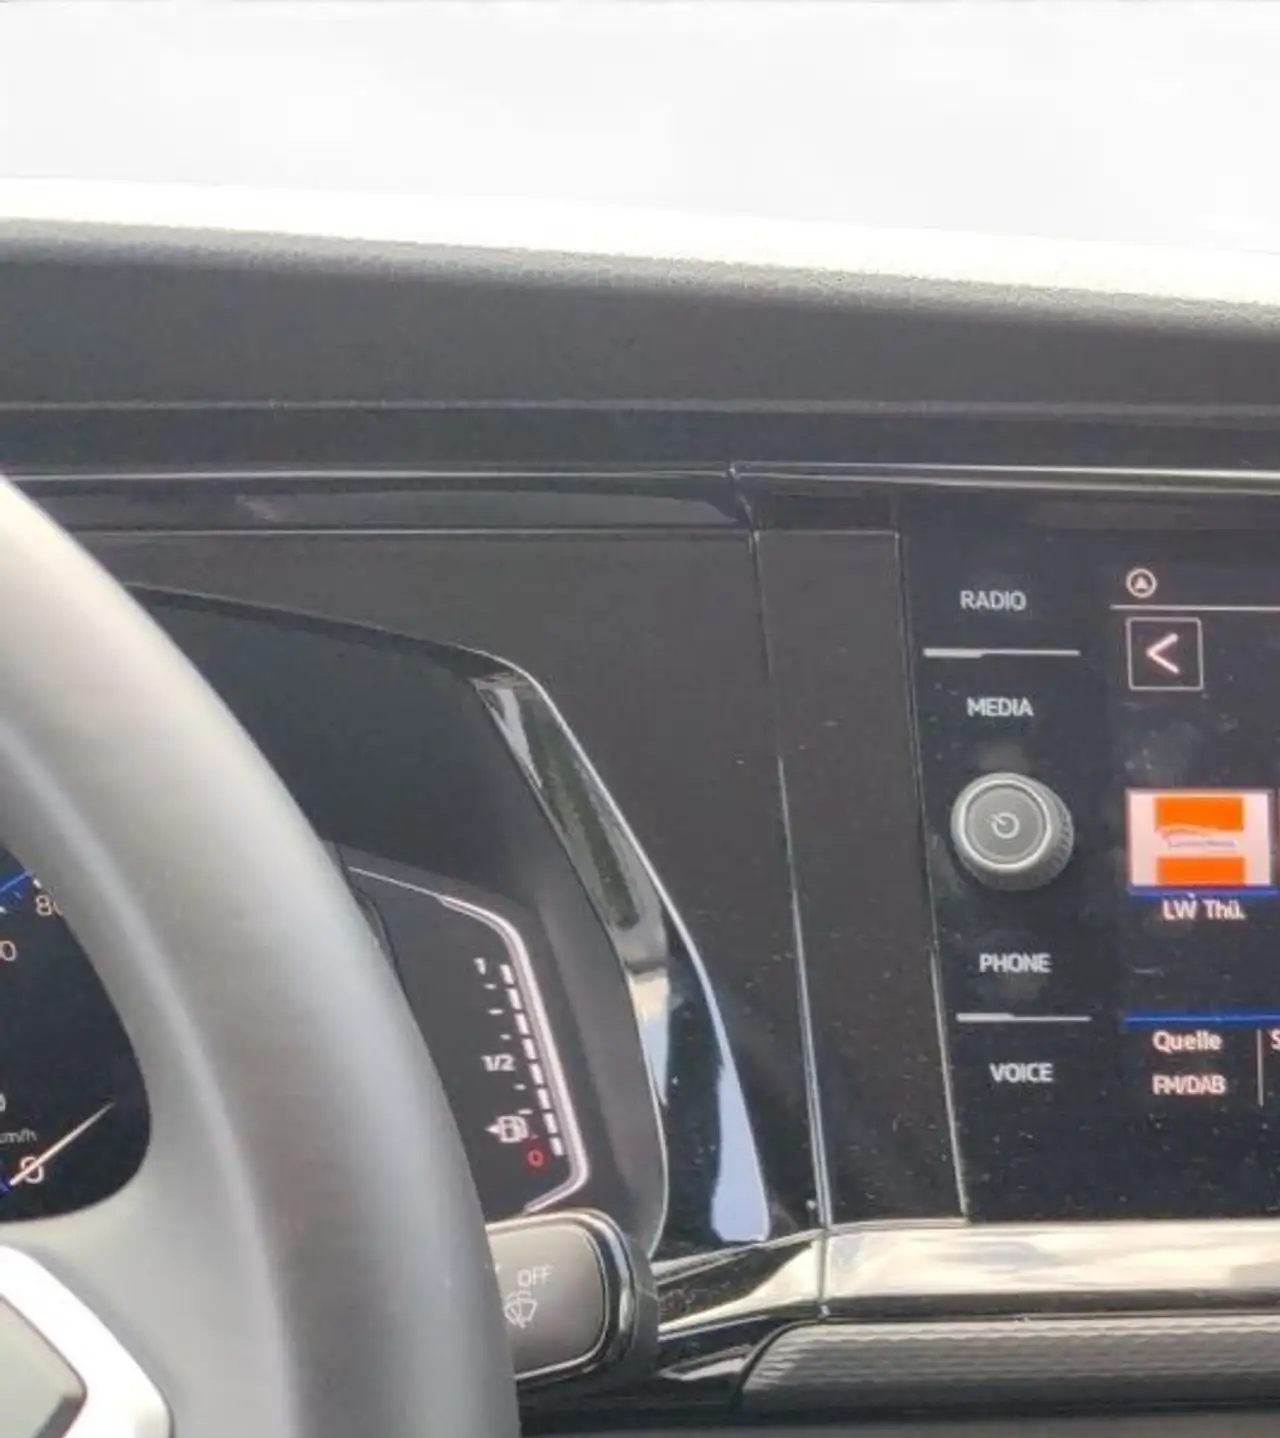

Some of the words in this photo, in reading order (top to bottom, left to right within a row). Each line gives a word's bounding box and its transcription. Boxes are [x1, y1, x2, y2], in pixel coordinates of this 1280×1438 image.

[960, 590, 1026, 612] RADIO
[967, 698, 1034, 718] MEDIA
[36, 895, 62, 917] 8
[1162, 898, 1197, 920] LW
[979, 953, 1051, 974] PHONE
[1153, 1030, 1223, 1053] Quelle
[482, 1054, 515, 1071] 1/2
[990, 1064, 1053, 1083] VOICE
[1153, 1074, 1227, 1095] FM/DAB
[518, 1265, 552, 1287] OFF
